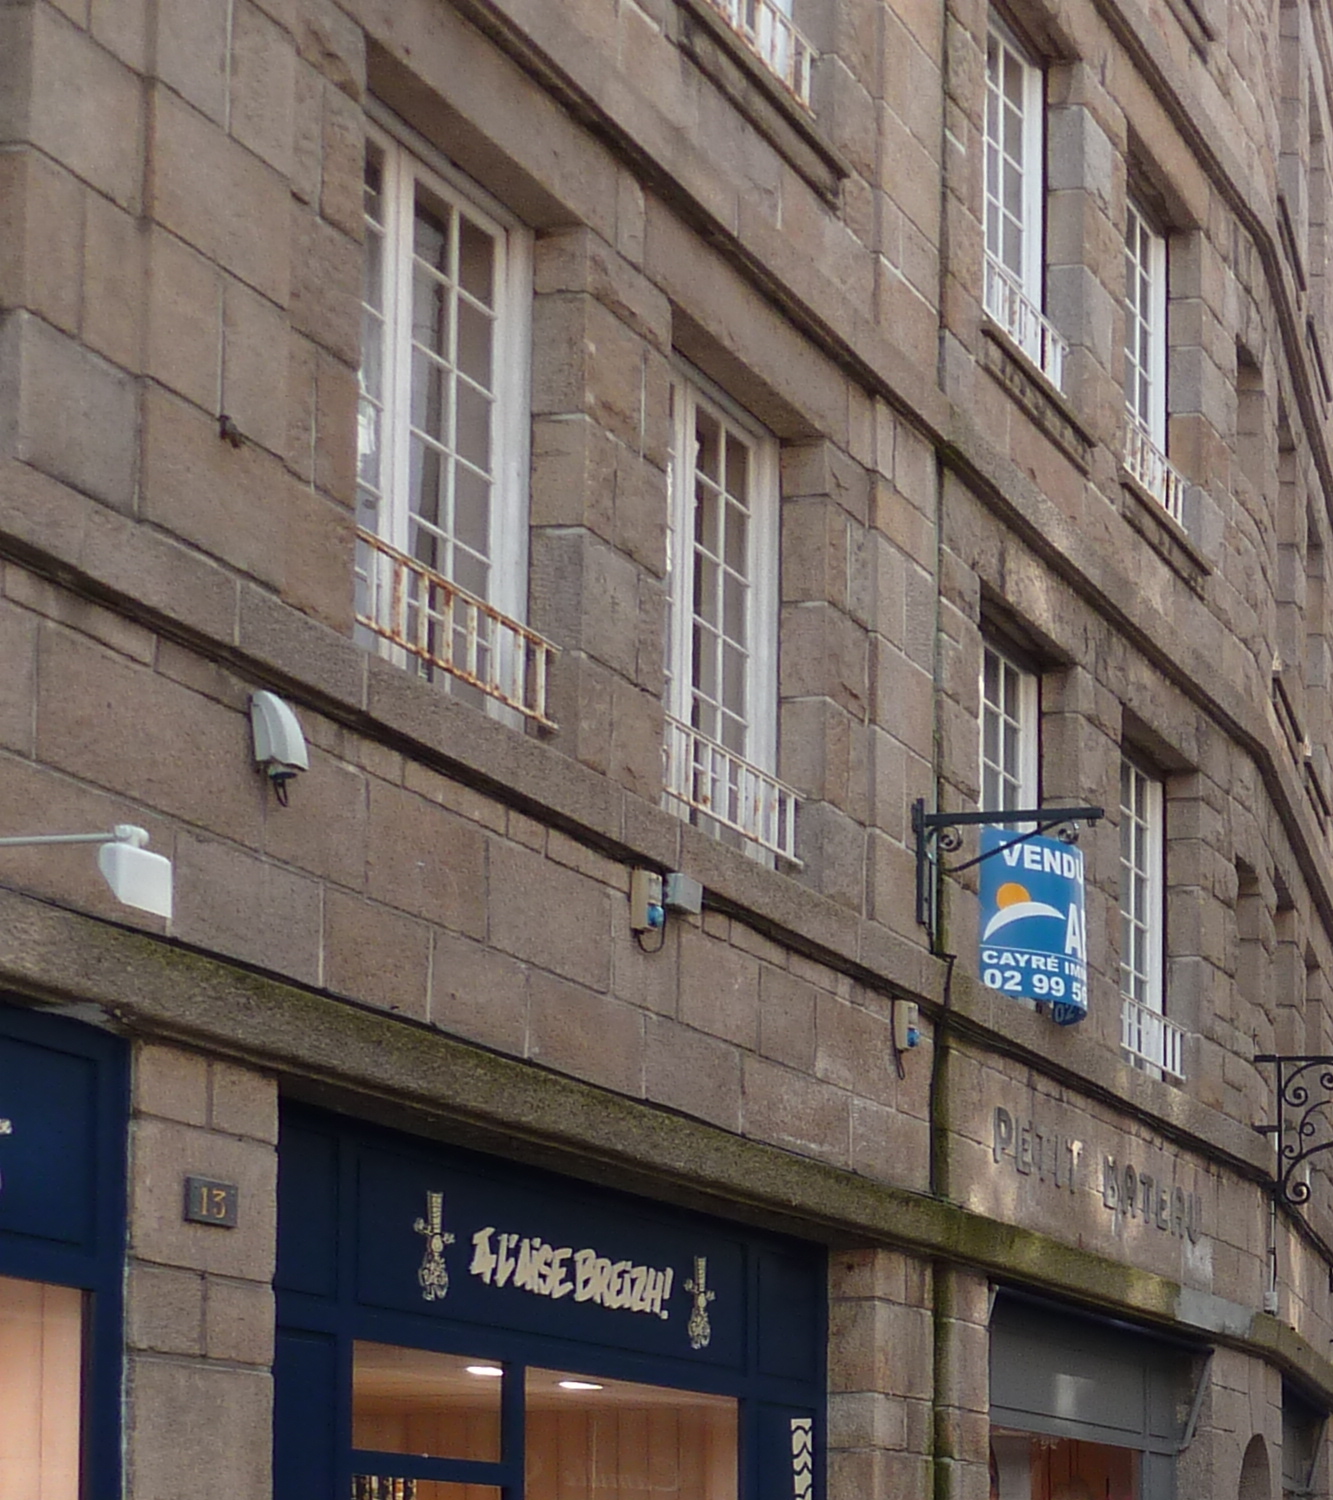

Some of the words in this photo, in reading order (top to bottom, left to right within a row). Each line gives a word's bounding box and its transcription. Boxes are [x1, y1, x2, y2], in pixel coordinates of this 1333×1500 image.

[982, 951, 1059, 972] CAYRÉ
[984, 969, 1022, 992] 02
[1032, 974, 1066, 998] 99
[993, 1106, 1085, 1196] PETIT
[1103, 1155, 1203, 1246] BATEAU
[201, 1186, 226, 1218] 13
